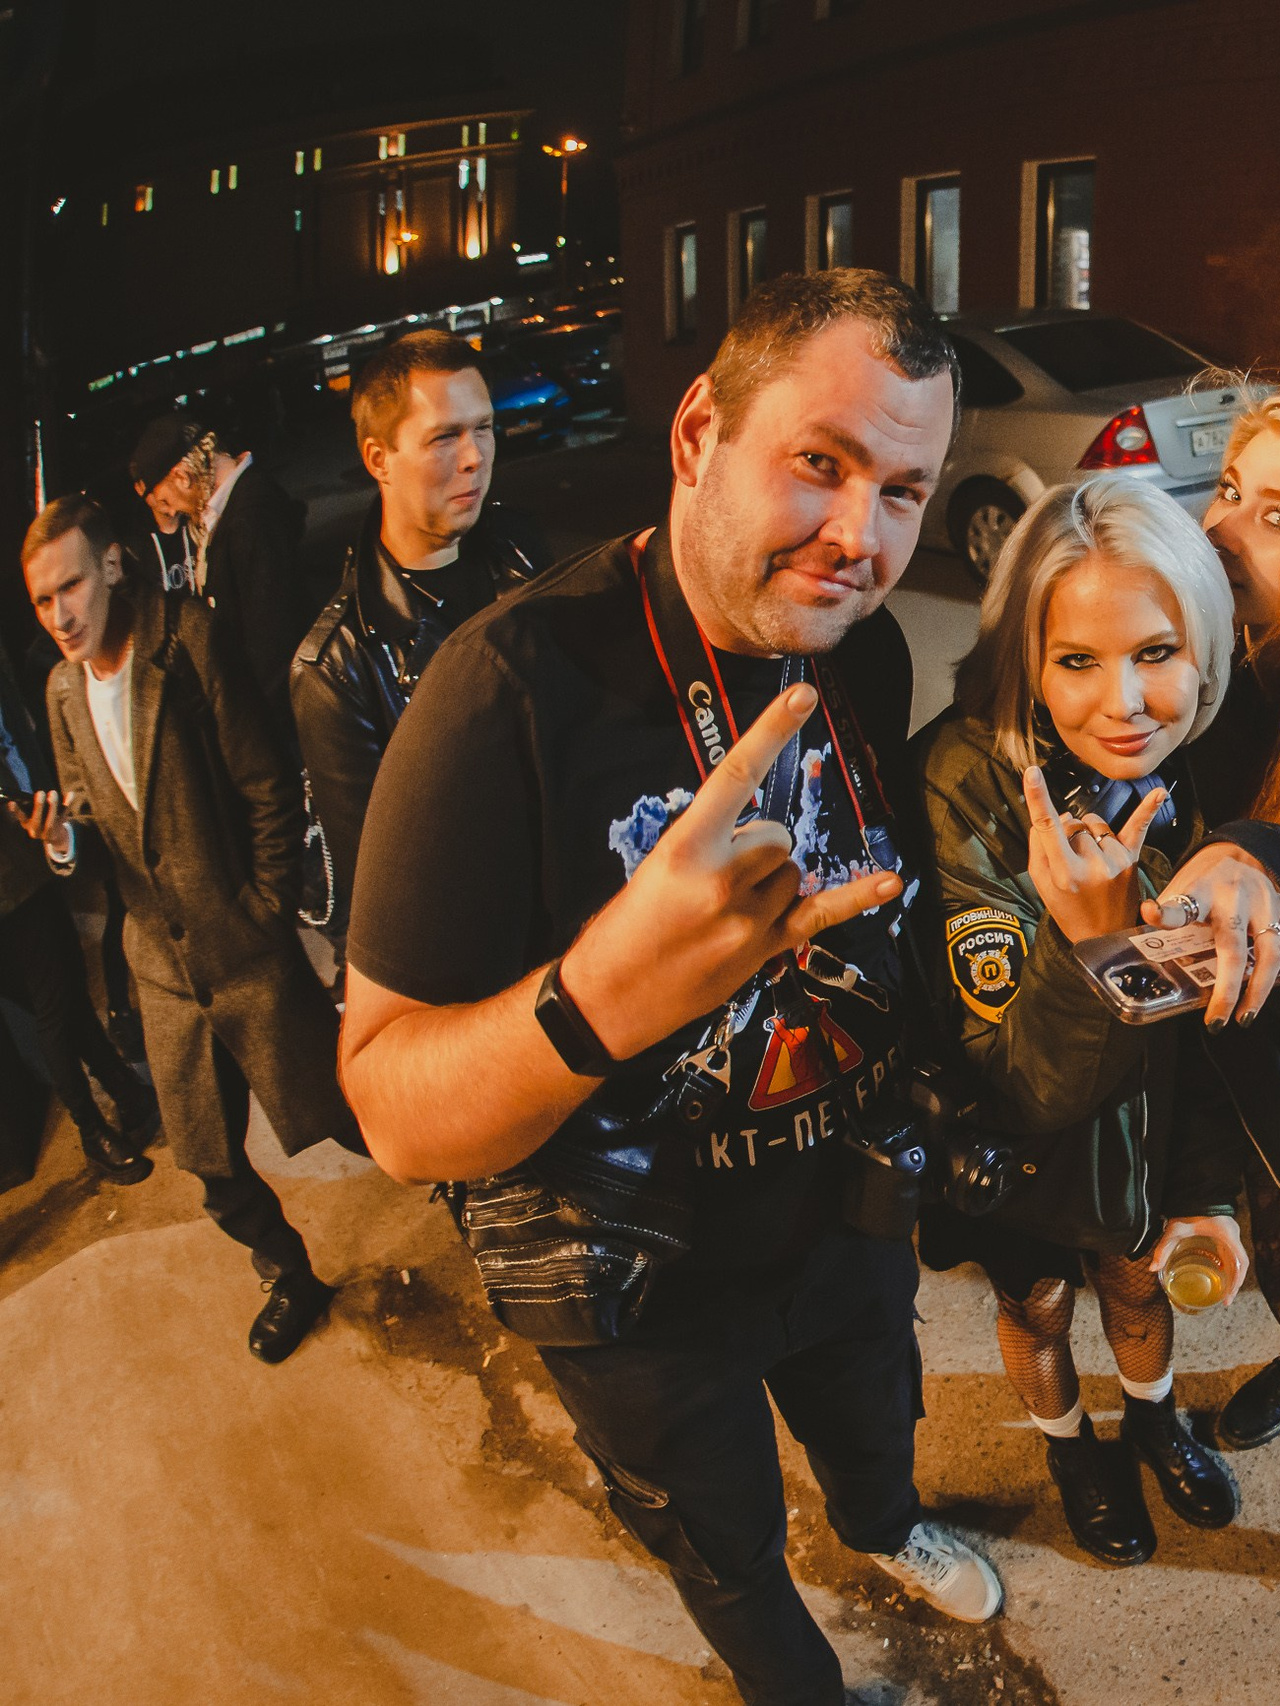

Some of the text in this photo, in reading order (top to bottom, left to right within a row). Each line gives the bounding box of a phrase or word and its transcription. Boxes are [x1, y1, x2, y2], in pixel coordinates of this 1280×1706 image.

[688, 680, 726, 765] Cano
[958, 932, 1015, 956] РОССИЯ
[984, 963, 997, 978] П
